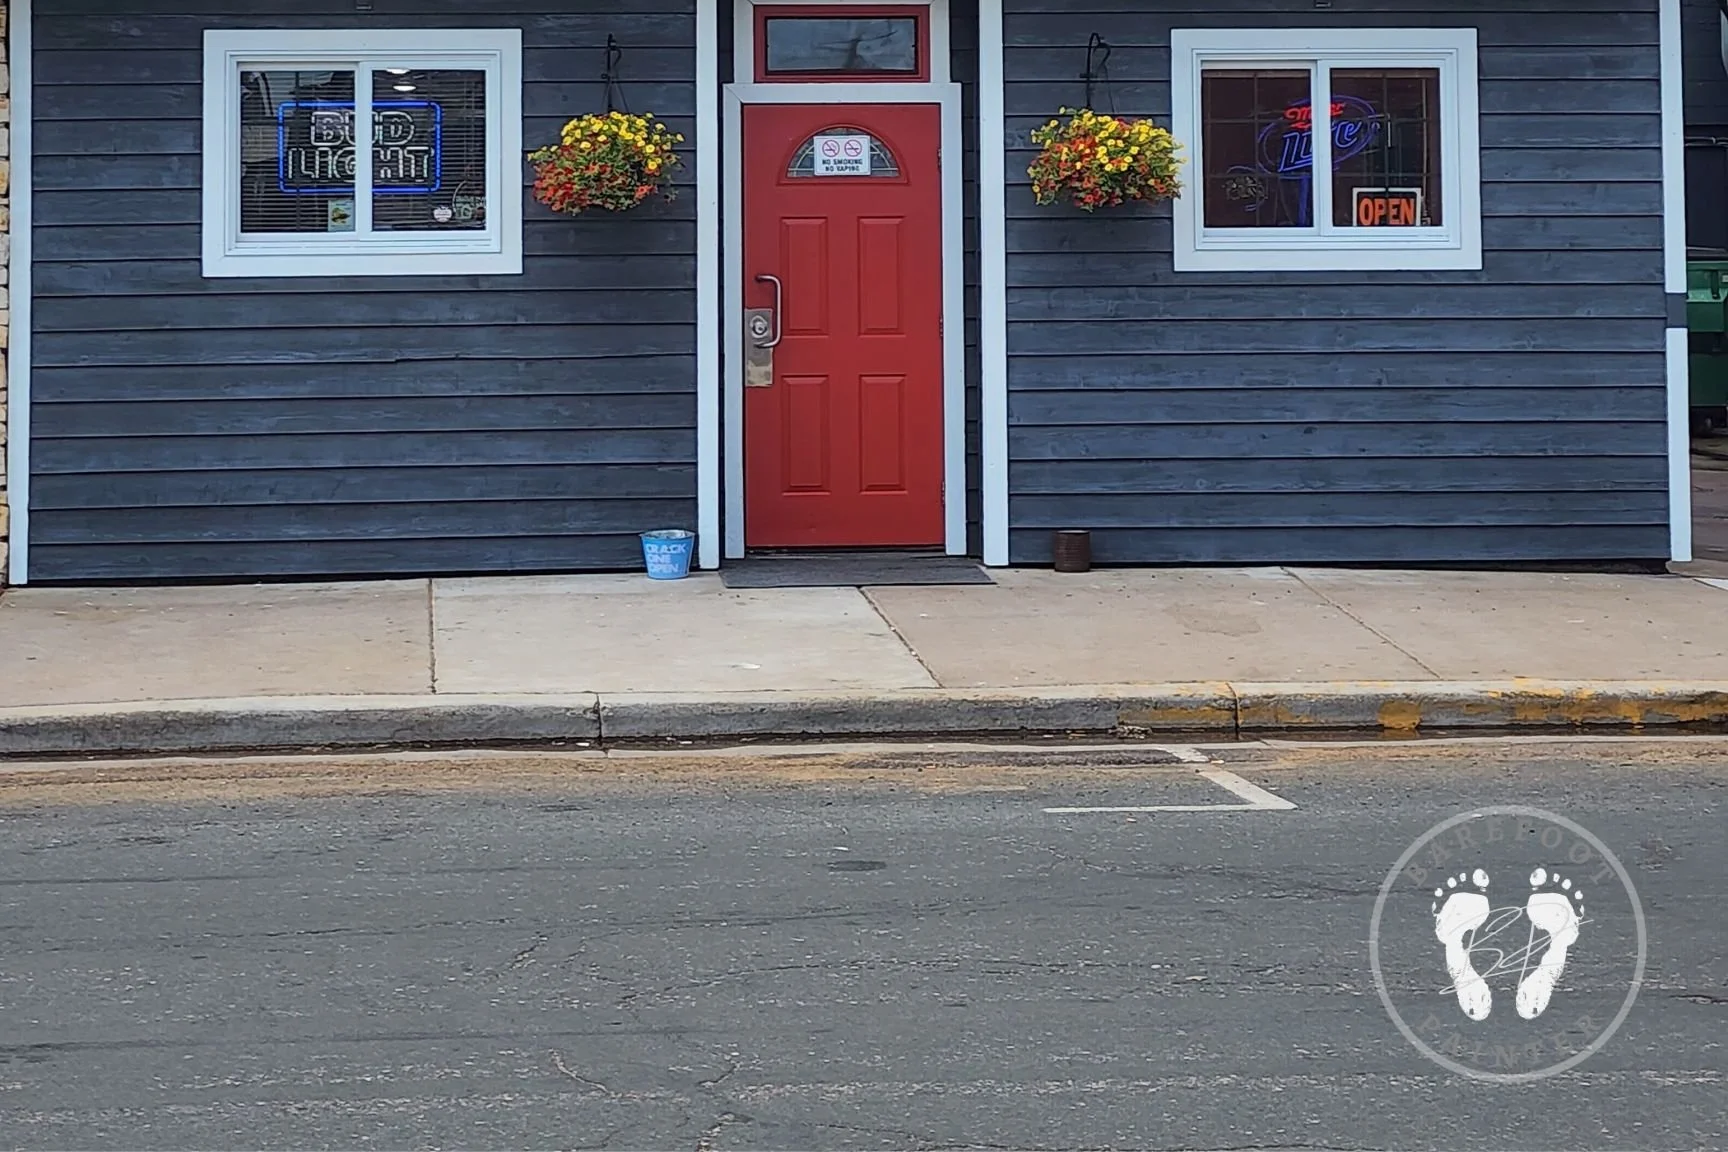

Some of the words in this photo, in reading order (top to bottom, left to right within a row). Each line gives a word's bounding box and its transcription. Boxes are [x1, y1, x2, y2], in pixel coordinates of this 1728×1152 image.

[822, 158, 831, 166] NO
[833, 158, 863, 166] SMOKING
[1359, 198, 1415, 226] OPEN
[647, 554, 672, 563] ONE
